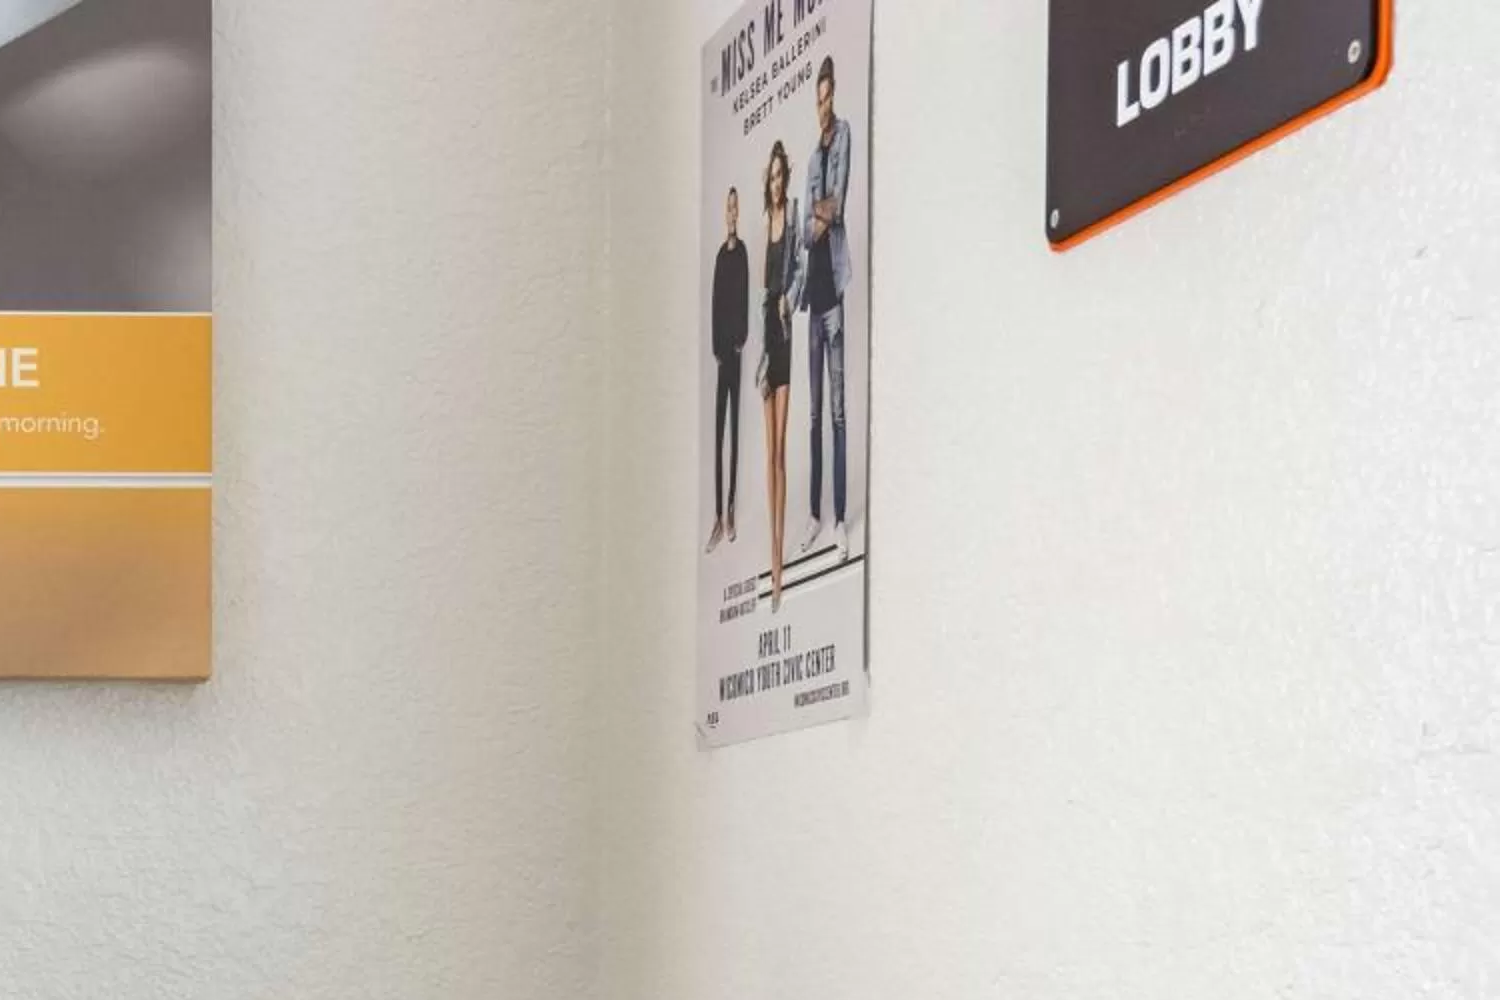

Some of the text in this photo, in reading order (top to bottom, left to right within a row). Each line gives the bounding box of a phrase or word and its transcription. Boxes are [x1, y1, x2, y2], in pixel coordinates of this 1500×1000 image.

[721, 20, 755, 97] MISS
[763, 0, 785, 57] ME
[1116, 0, 1264, 129] LOBBY
[0, 413, 105, 440] morning.
[805, 643, 836, 679] CENTER
